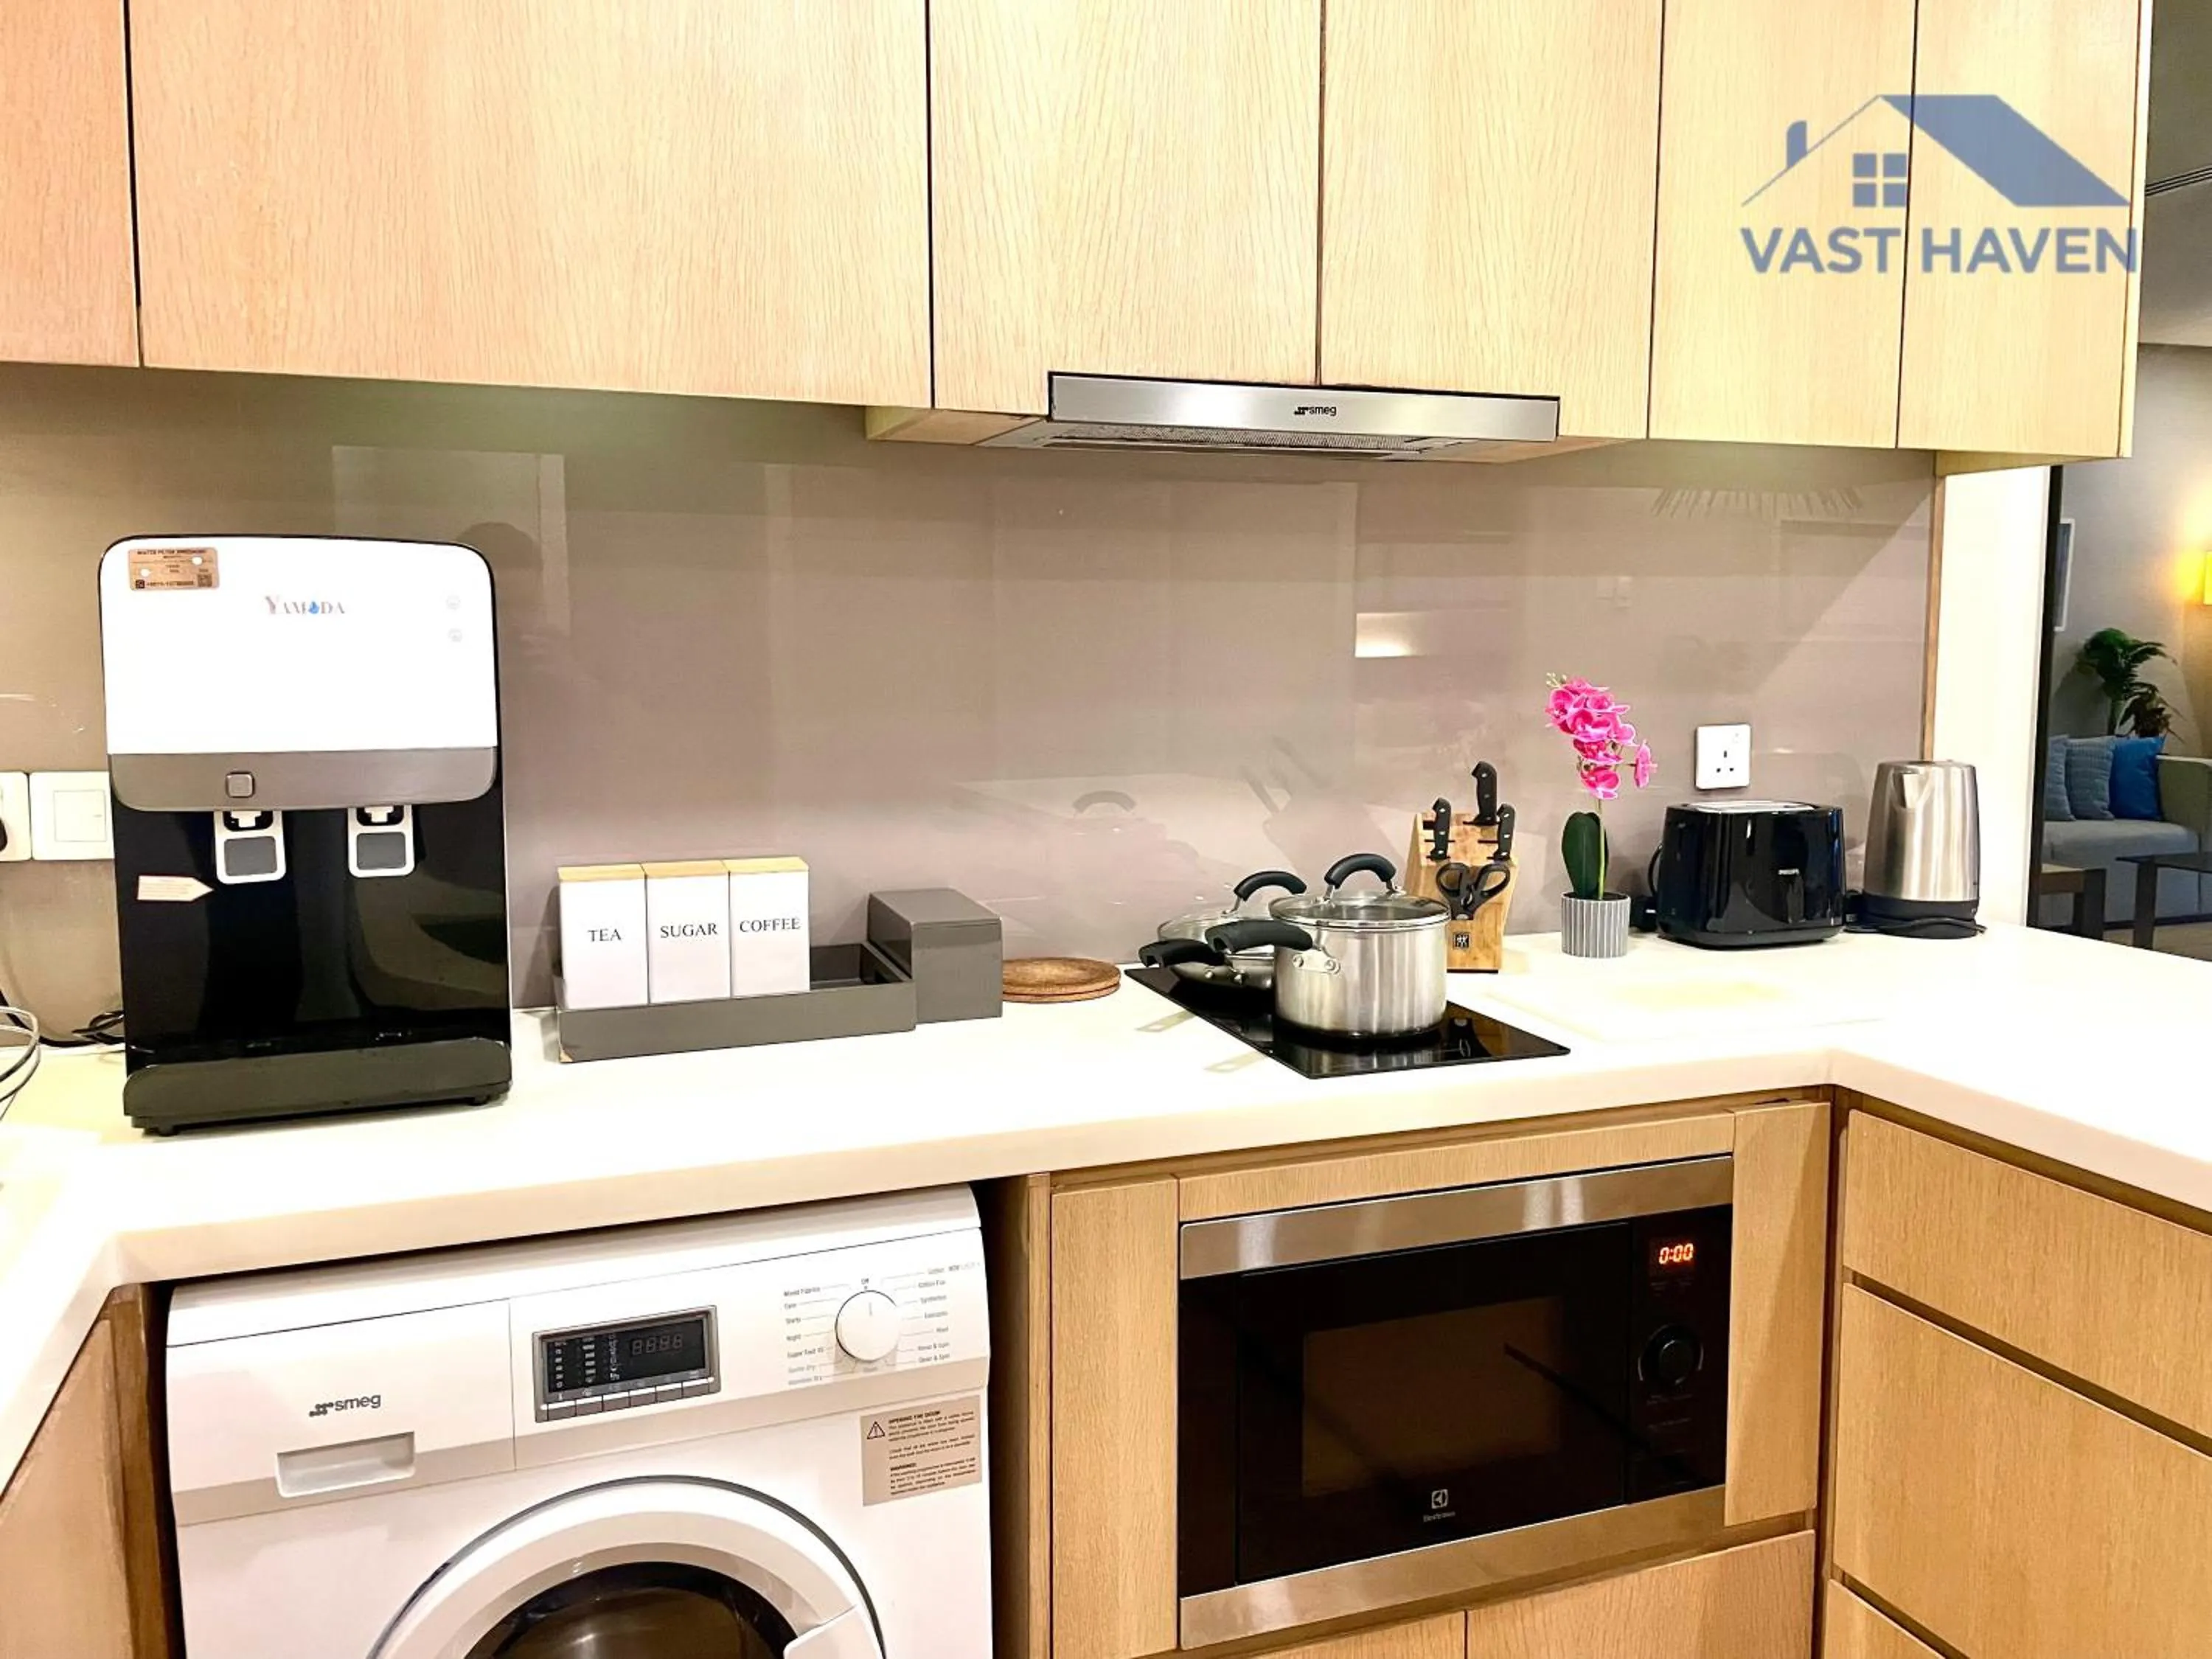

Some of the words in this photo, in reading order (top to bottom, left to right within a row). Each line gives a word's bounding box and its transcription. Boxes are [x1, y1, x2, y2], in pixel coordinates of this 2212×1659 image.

[1309, 406, 1337, 417] smeg
[660, 922, 718, 939] SUGAR
[739, 917, 801, 933] COFFEE
[588, 928, 622, 942] TEA
[1659, 1242, 1694, 1265] 0:00
[335, 1394, 381, 1411] smeg
